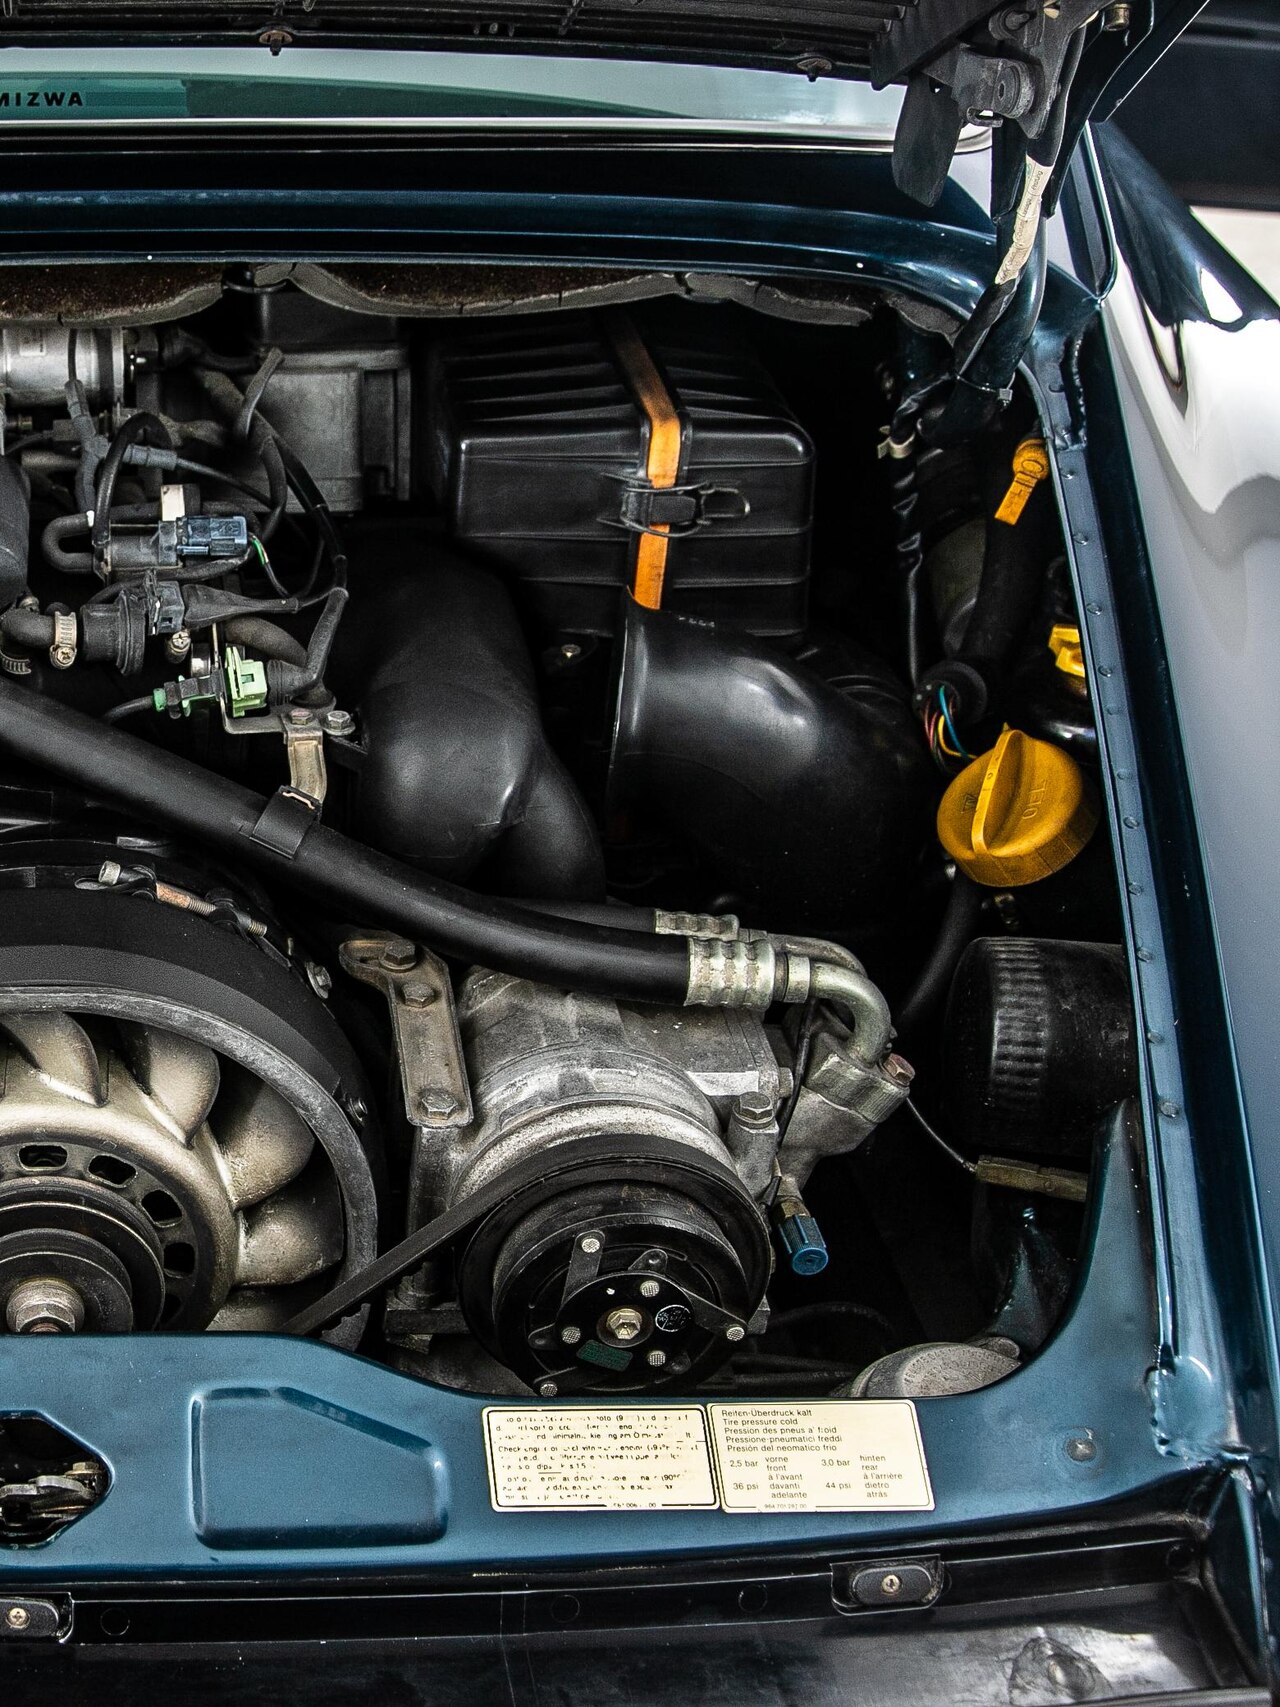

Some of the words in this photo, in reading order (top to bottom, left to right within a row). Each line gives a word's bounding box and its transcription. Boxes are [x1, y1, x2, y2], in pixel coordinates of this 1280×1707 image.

[741, 1419, 778, 1427] pressure
[762, 1426, 778, 1434] des
[780, 1427, 805, 1435] pneus
[727, 1444, 759, 1452] Presión
[761, 1444, 774, 1452] del
[729, 1459, 742, 1468] 2,5
[821, 1459, 834, 1467] 3,0
[732, 1482, 745, 1490] 36
[746, 1482, 759, 1491] psi
[838, 1482, 851, 1490] psi
[864, 1481, 890, 1489] dietro
[771, 1491, 808, 1499] adelante
[866, 1490, 888, 1498] atrás
